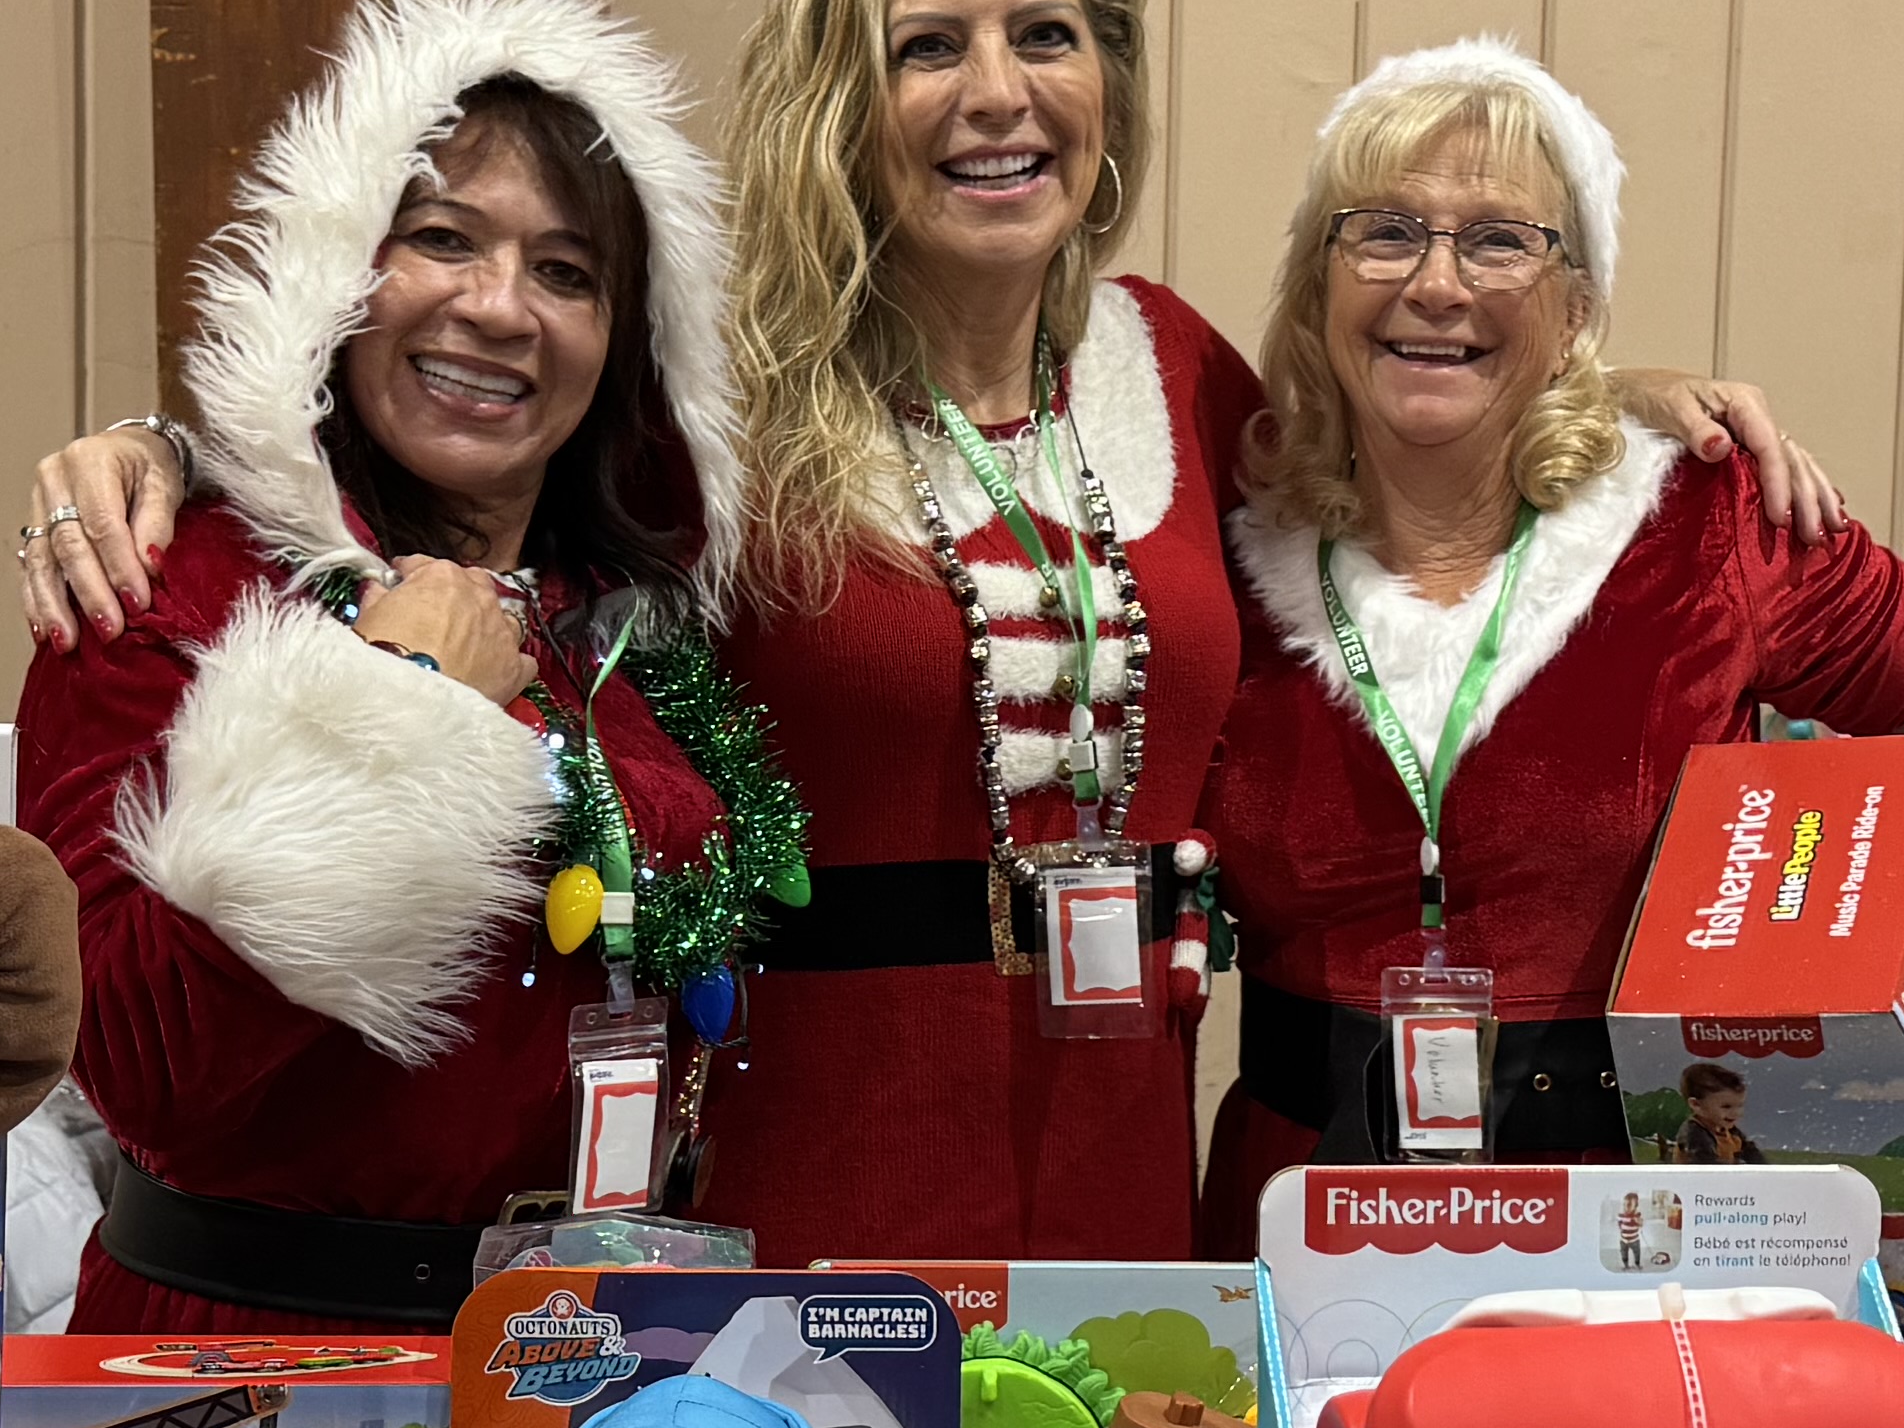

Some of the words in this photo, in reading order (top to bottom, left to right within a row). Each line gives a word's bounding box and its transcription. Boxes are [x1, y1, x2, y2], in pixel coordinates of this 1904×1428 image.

[940, 398, 1015, 515] VOLUNTEER
[1322, 572, 1368, 677] VOLUNTEER
[1686, 787, 1775, 950] fisher-price
[1829, 895, 1853, 937] Music
[1841, 836, 1870, 892] Parade
[1860, 786, 1885, 834] Ride-on
[1326, 1186, 1546, 1228] Fisher-Price
[1694, 1193, 1756, 1208] Rewards
[1694, 1234, 1730, 1251] Bébé
[1736, 1237, 1756, 1251] est
[1760, 1234, 1849, 1254] récompensé
[514, 1319, 612, 1339] OCTONAUTS
[807, 1307, 842, 1323] I'M
[848, 1307, 927, 1324] CAPTAIN
[807, 1323, 928, 1340] BARNACLES!
[492, 1338, 600, 1374] ABOVE
[599, 1334, 623, 1358] &
[517, 1352, 640, 1395] BEYOND
